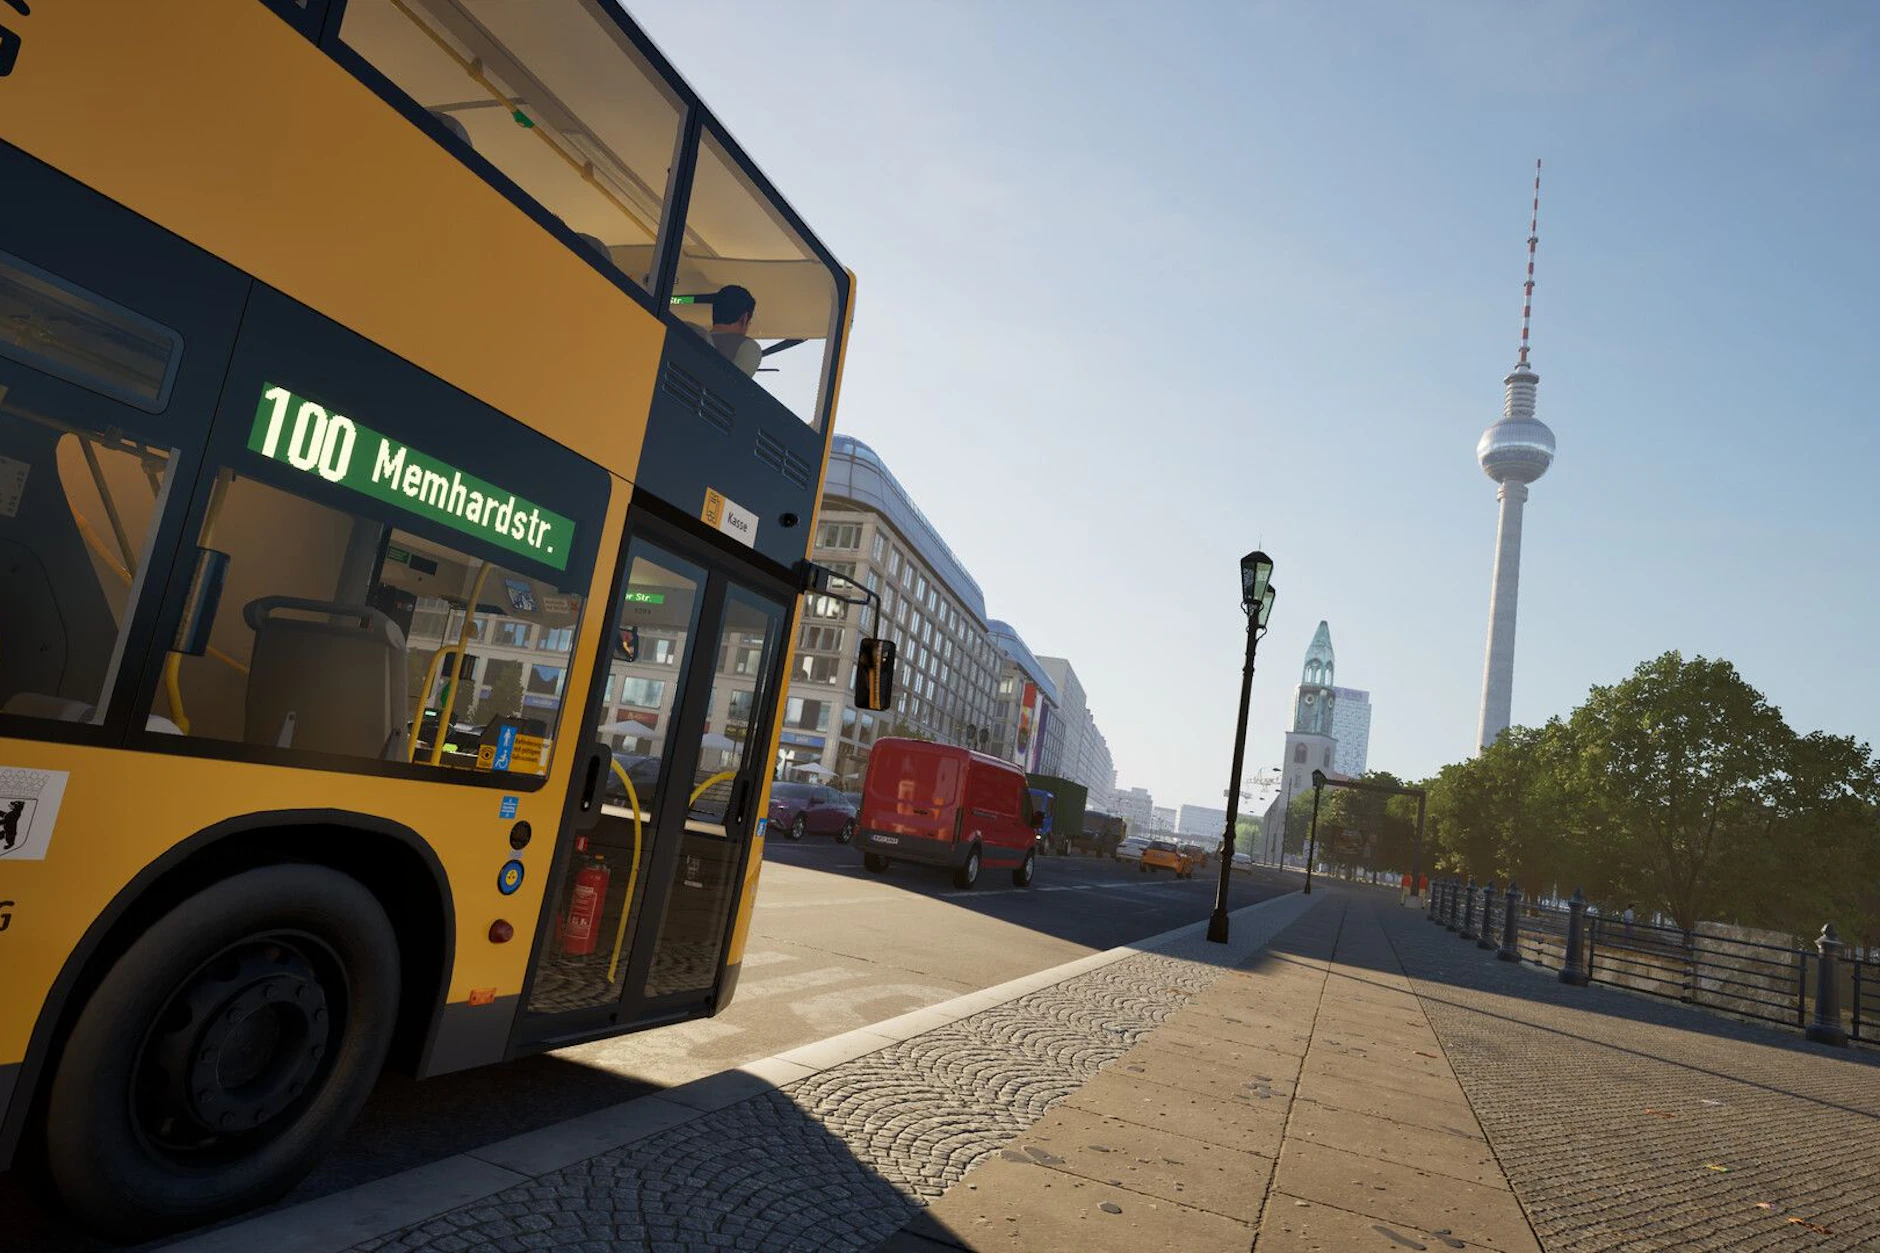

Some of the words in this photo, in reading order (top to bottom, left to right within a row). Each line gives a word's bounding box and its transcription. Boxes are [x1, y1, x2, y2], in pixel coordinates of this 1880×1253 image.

[262, 387, 357, 482] 100
[372, 438, 554, 553] Memhardstr.
[727, 511, 748, 532] Kasse
